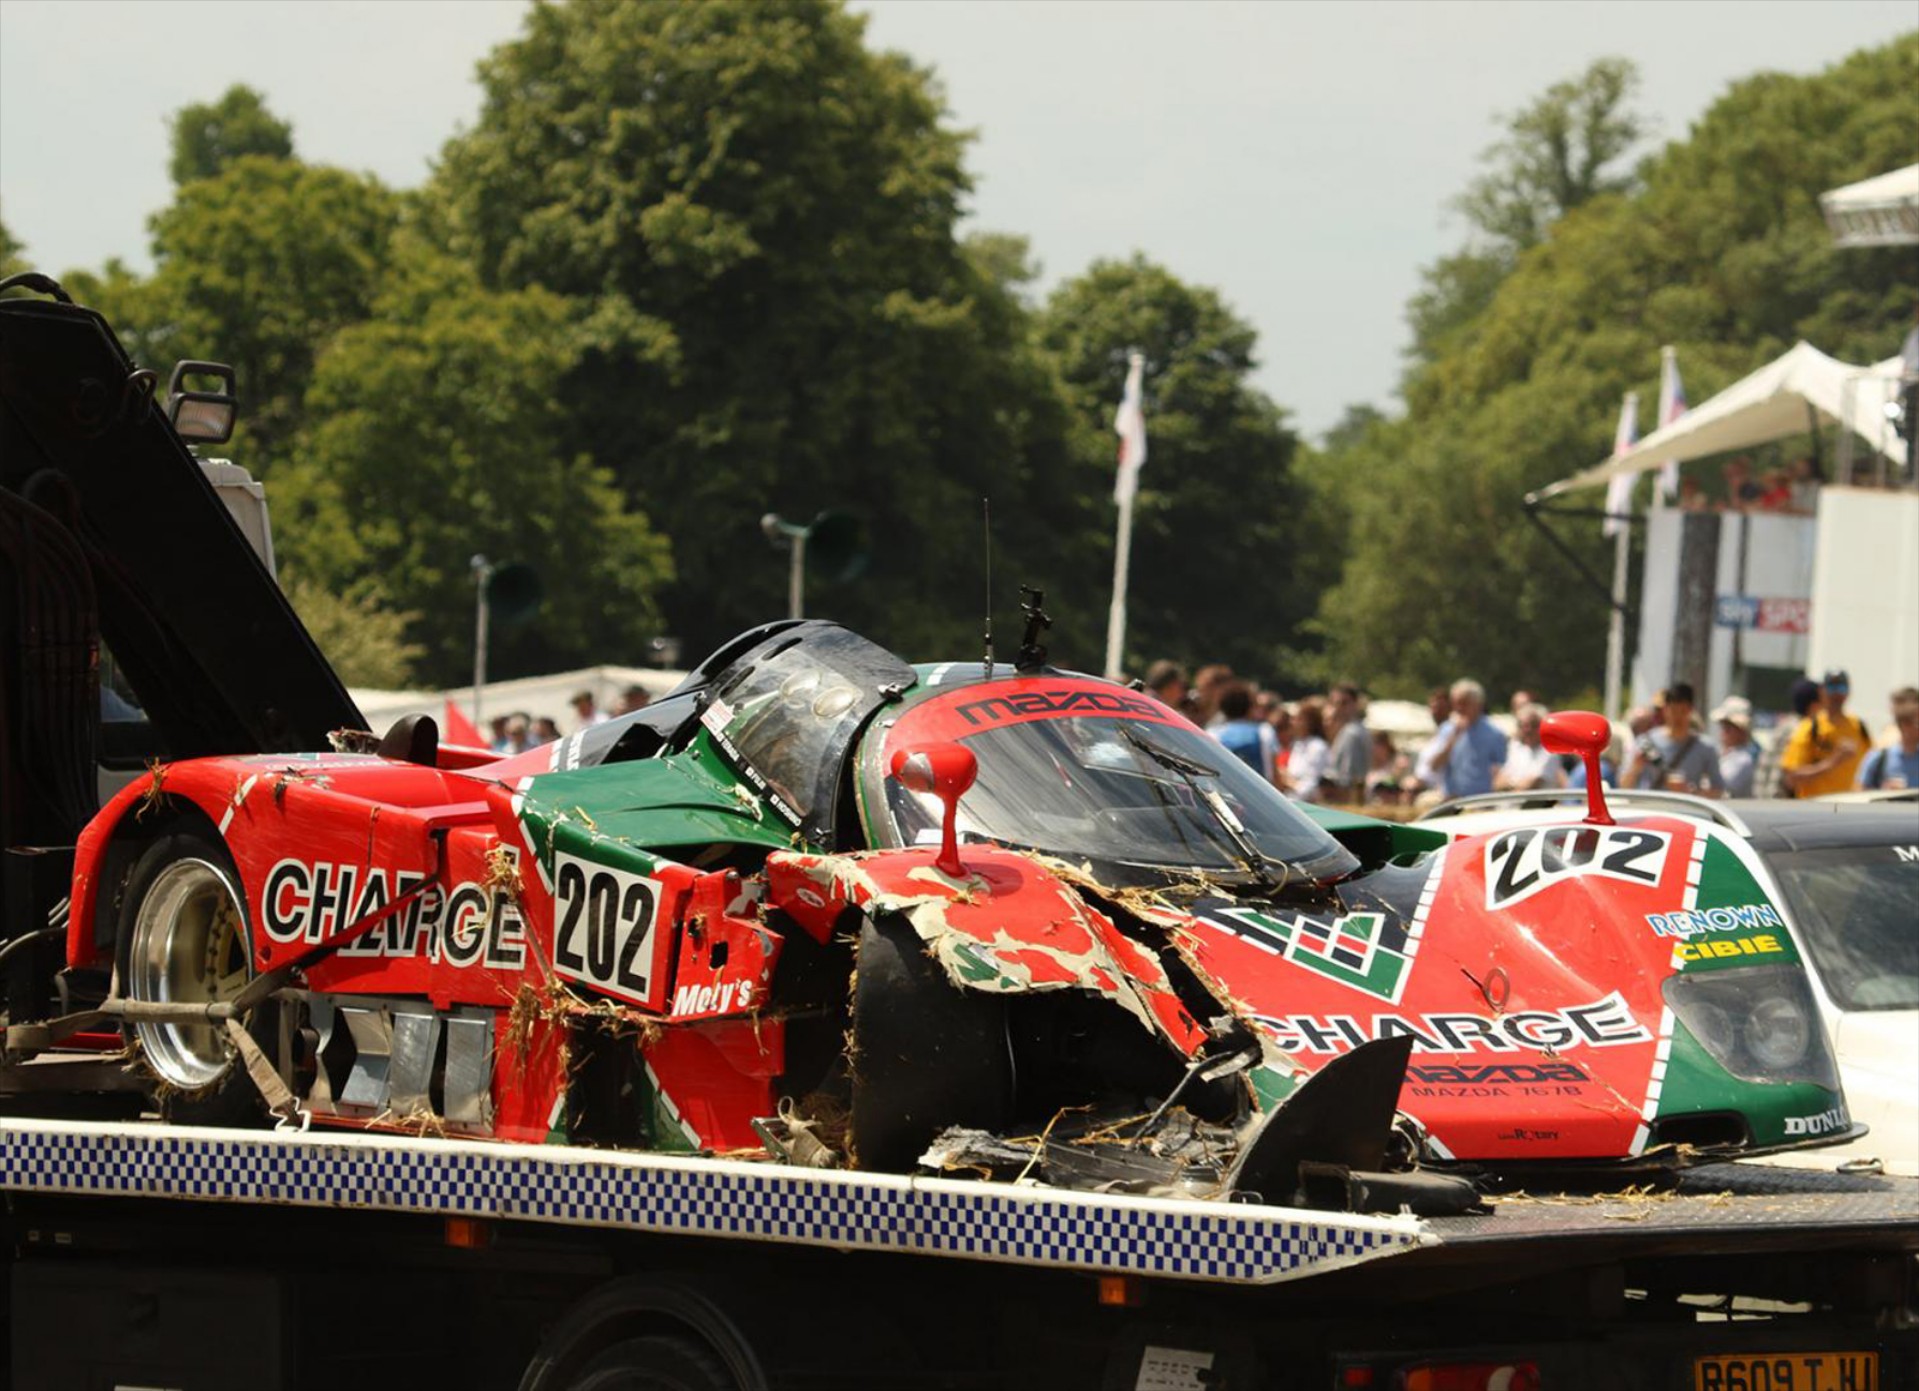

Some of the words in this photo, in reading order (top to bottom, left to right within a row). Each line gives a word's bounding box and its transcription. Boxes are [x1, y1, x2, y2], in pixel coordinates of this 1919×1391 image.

[1491, 828, 1667, 904] 202
[262, 857, 526, 970] CHARGE
[558, 862, 655, 995] 202
[1644, 904, 1783, 937] RENOWN
[1673, 935, 1783, 961] CIBIE
[1244, 990, 1655, 1054] CHARGE
[1411, 1086, 1510, 1097] MAZDA
[1517, 1085, 1583, 1097] 767B
[1702, 1359, 1794, 1391] R609
